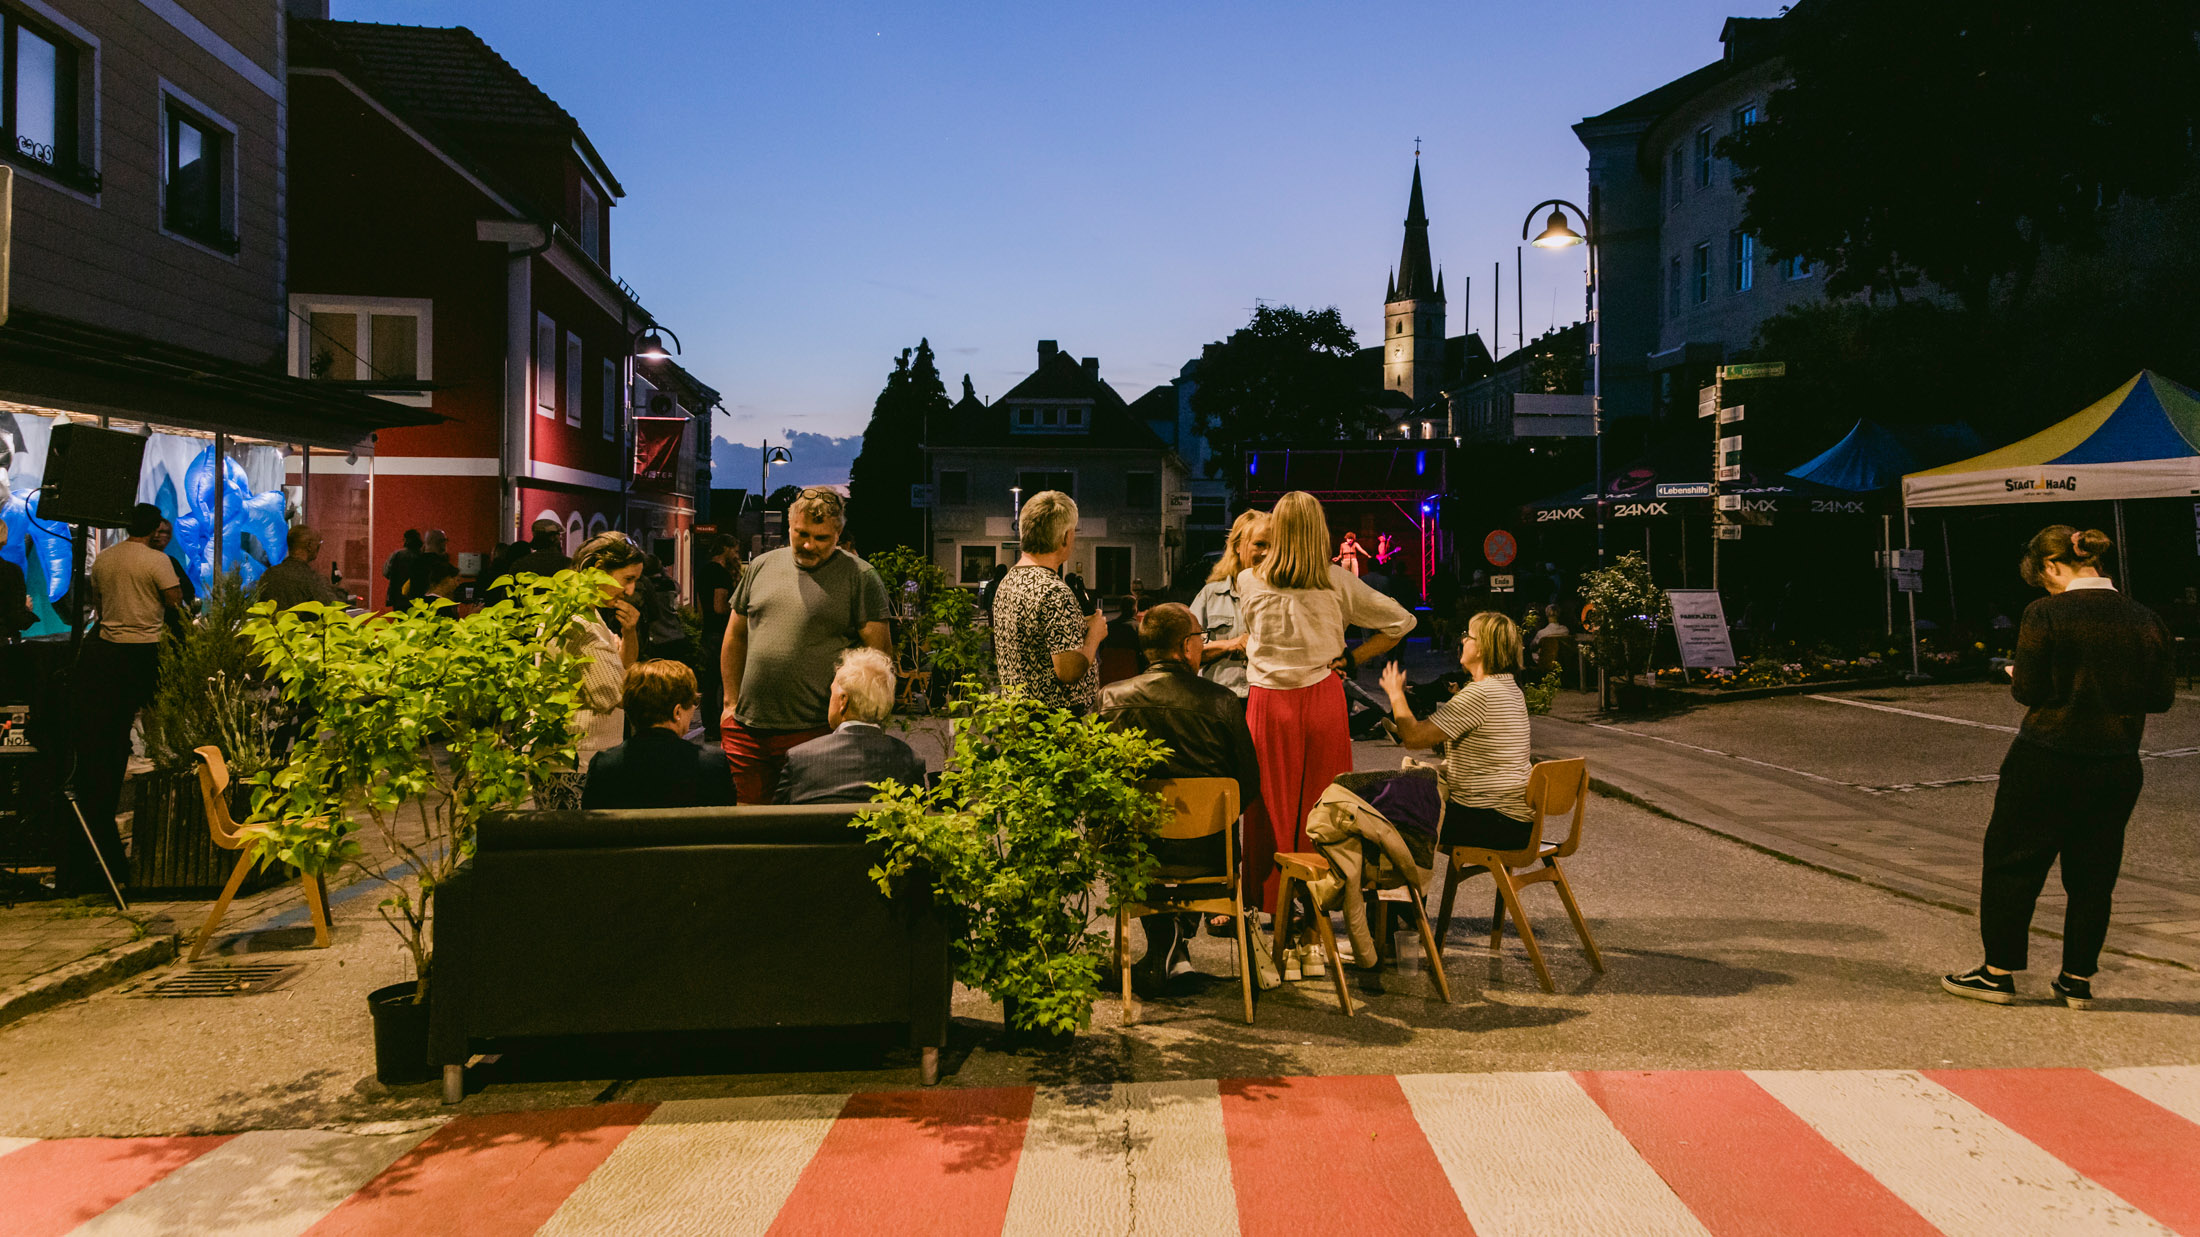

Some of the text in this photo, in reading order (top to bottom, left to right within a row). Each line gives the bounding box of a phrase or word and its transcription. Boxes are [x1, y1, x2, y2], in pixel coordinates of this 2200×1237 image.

[1663, 486, 1708, 494] Lebenshilfe
[1614, 502, 1669, 518] 24MX
[1811, 499, 1865, 513] 24MX
[1536, 507, 1585, 522] 24MX
